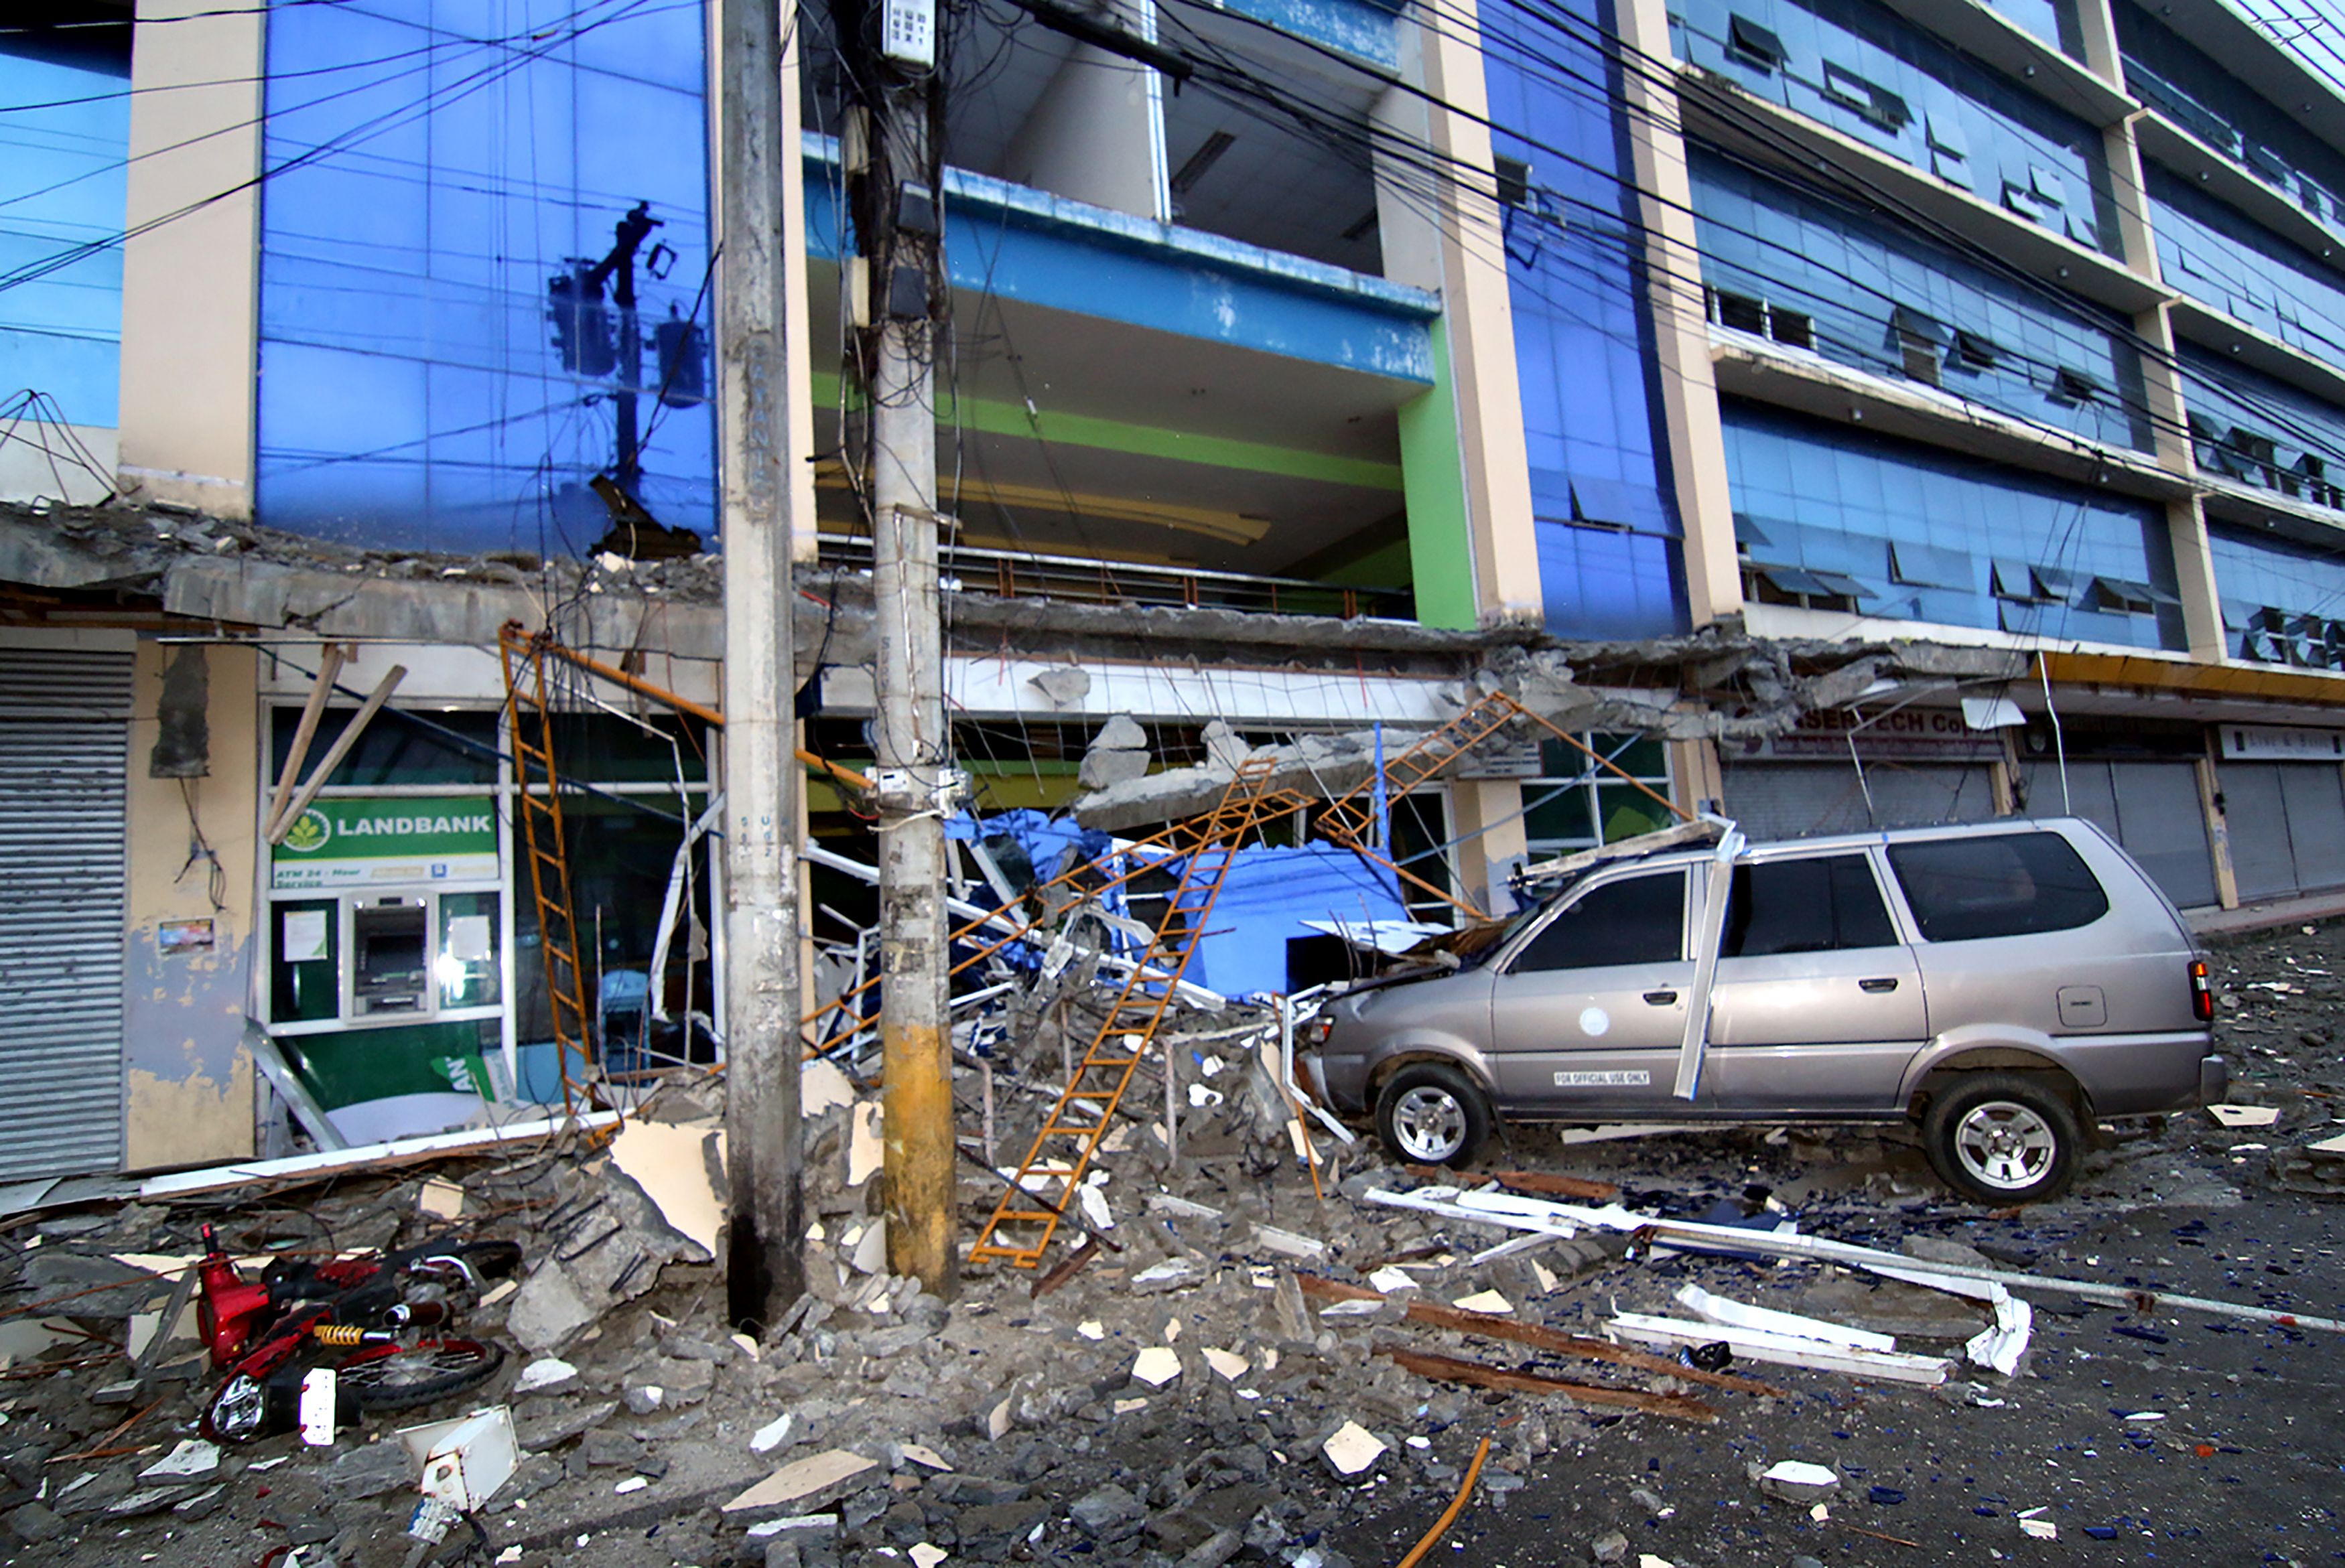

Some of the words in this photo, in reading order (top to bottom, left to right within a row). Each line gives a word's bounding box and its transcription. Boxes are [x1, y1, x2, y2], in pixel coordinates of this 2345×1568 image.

[1794, 707, 1924, 732] SERTECH
[337, 814, 491, 836] LANDBANK
[1556, 1073, 1571, 1083] FOR
[1573, 1072, 1607, 1083] OFFICIAL
[1609, 1072, 1625, 1082] USE
[1627, 1072, 1648, 1082] ONLY
